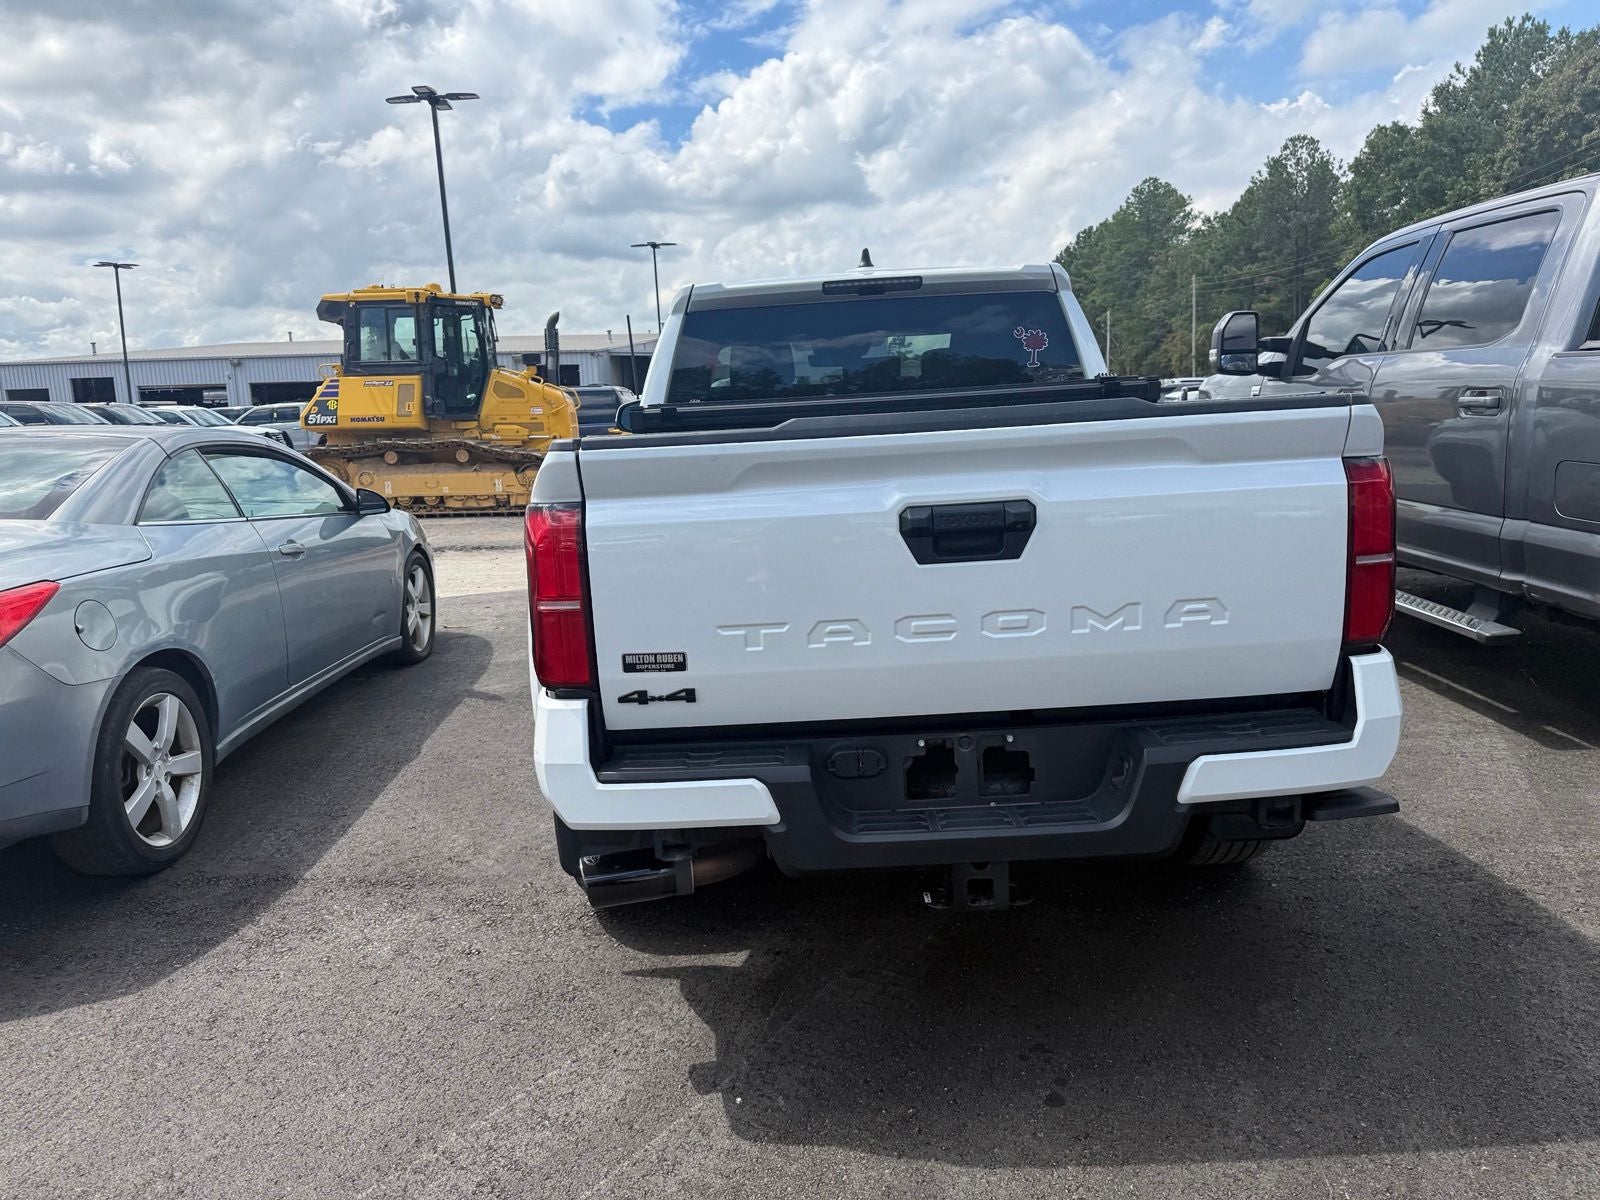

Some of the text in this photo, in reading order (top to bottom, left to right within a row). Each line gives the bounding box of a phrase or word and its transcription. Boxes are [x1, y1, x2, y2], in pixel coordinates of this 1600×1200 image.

[307, 413, 337, 424] 51PXi
[350, 415, 385, 423] KOMATSU
[716, 597, 1229, 651] TACOMA
[625, 653, 684, 664] MILTON RUBEN
